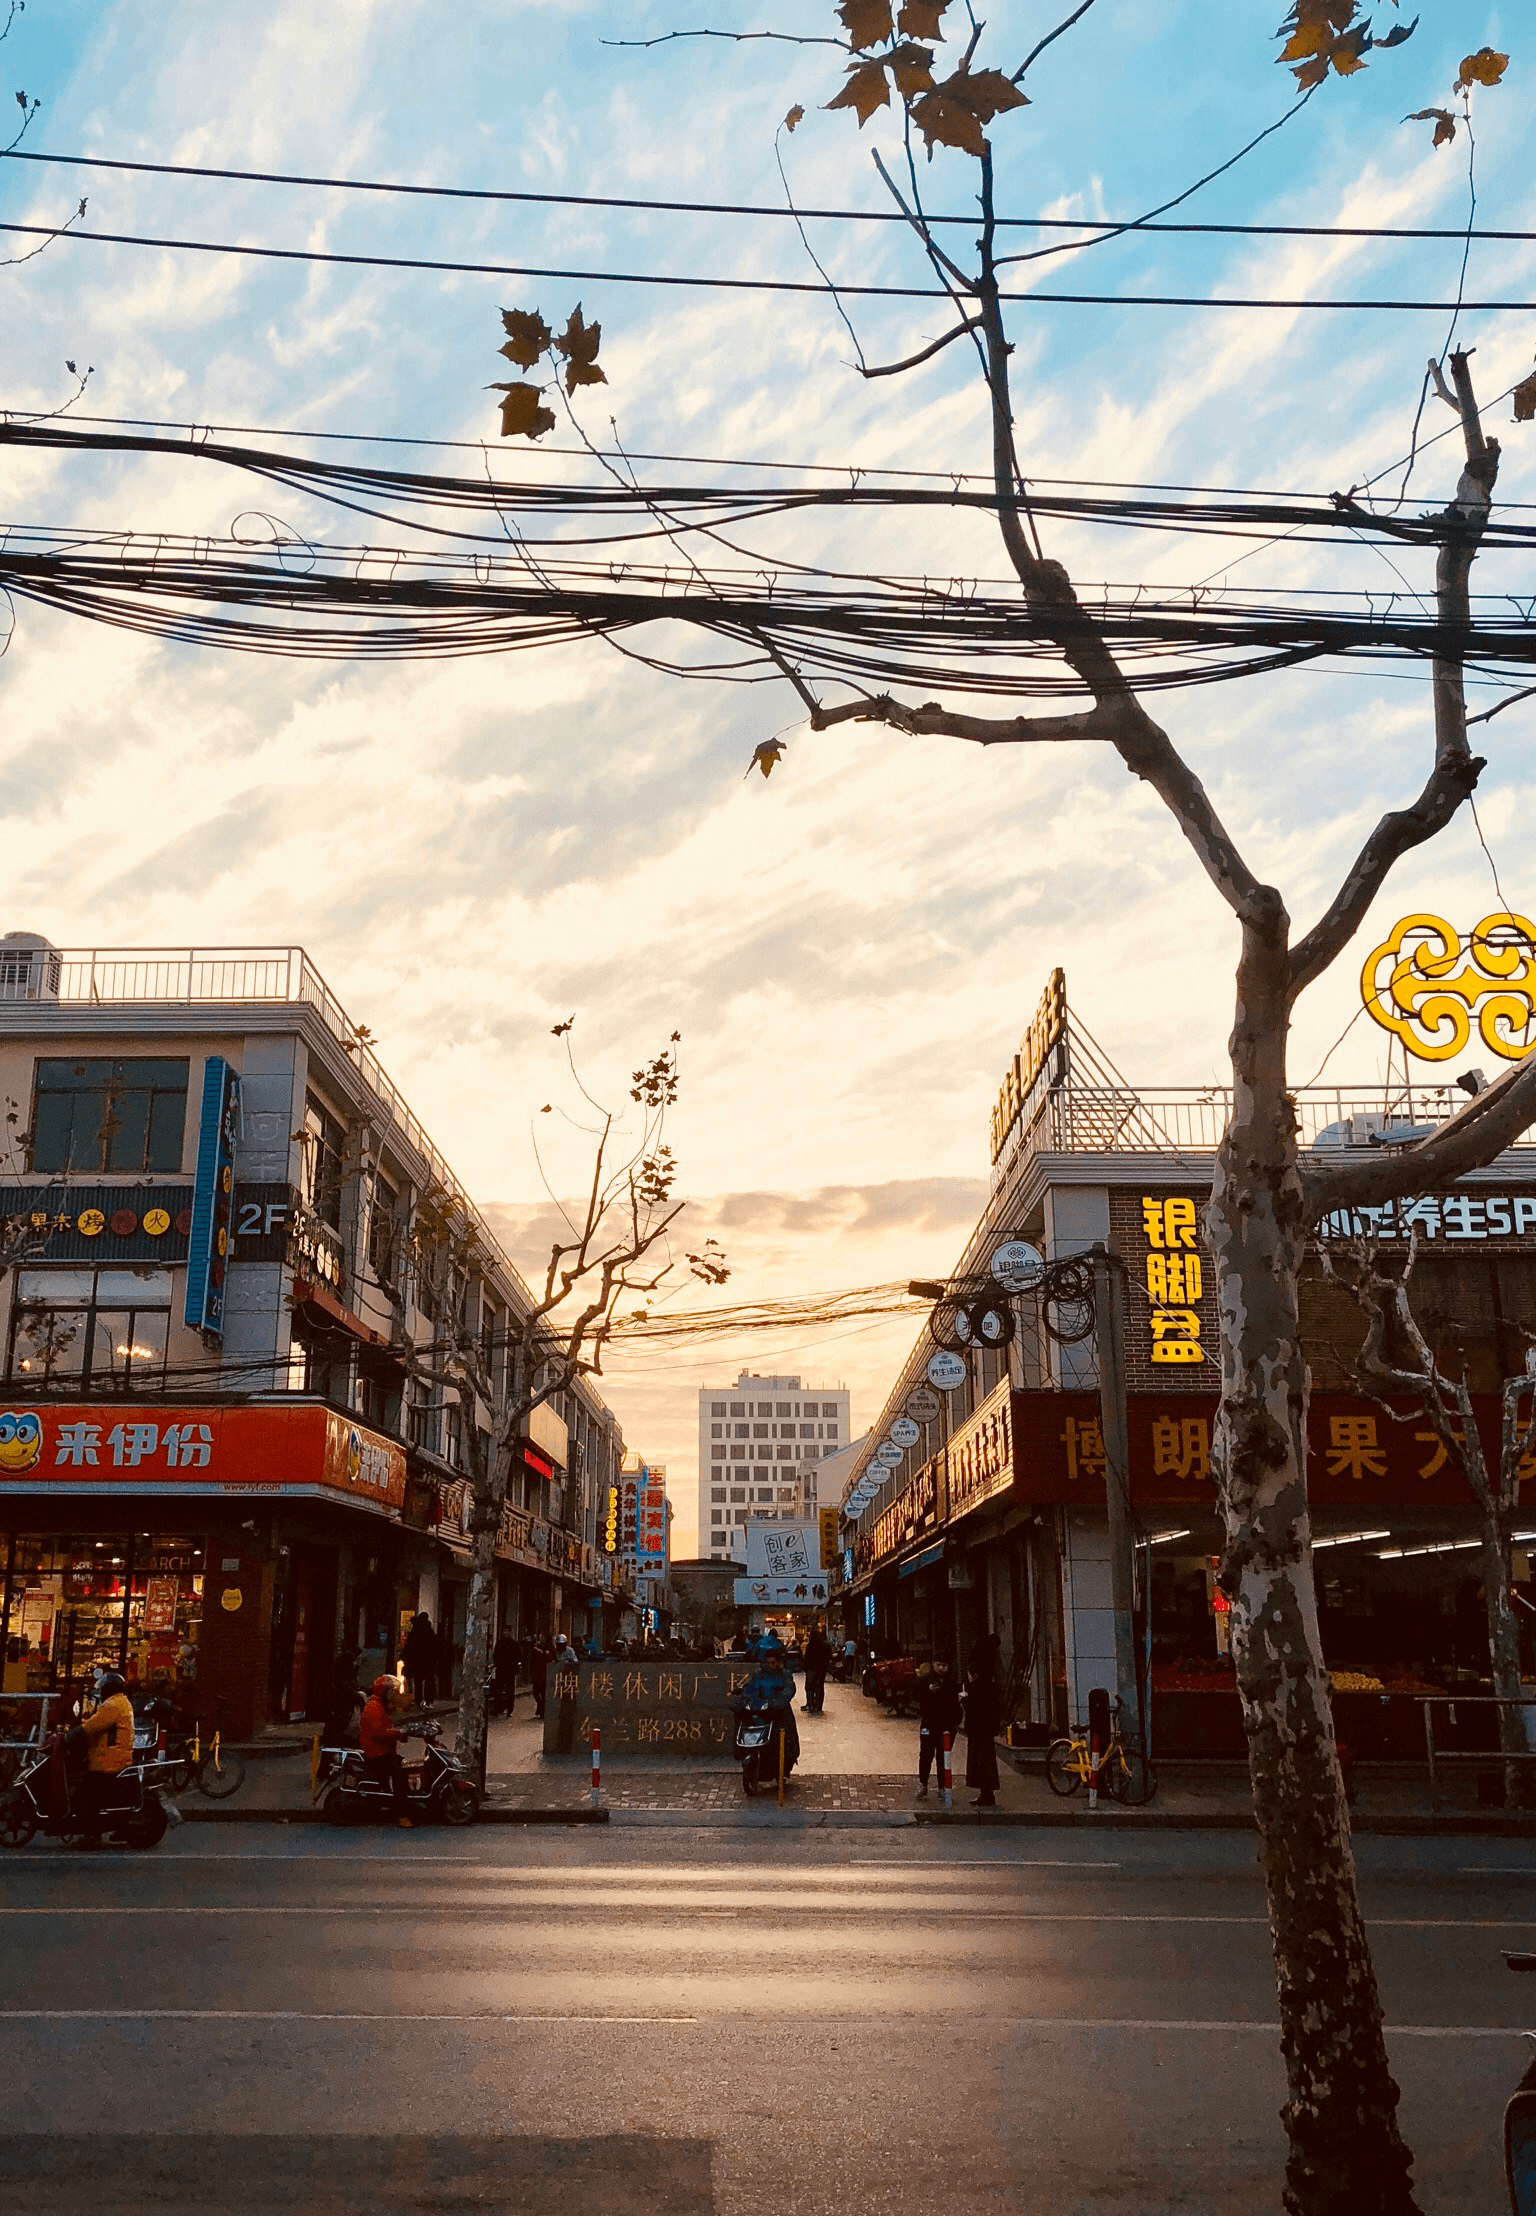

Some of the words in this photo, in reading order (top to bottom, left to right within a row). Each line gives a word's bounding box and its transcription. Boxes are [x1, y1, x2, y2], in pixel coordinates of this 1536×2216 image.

[238, 1204, 288, 1235] 2F
[55, 1421, 214, 1467] 来伊份
[553, 1671, 750, 1700] 牌楼休闲广场
